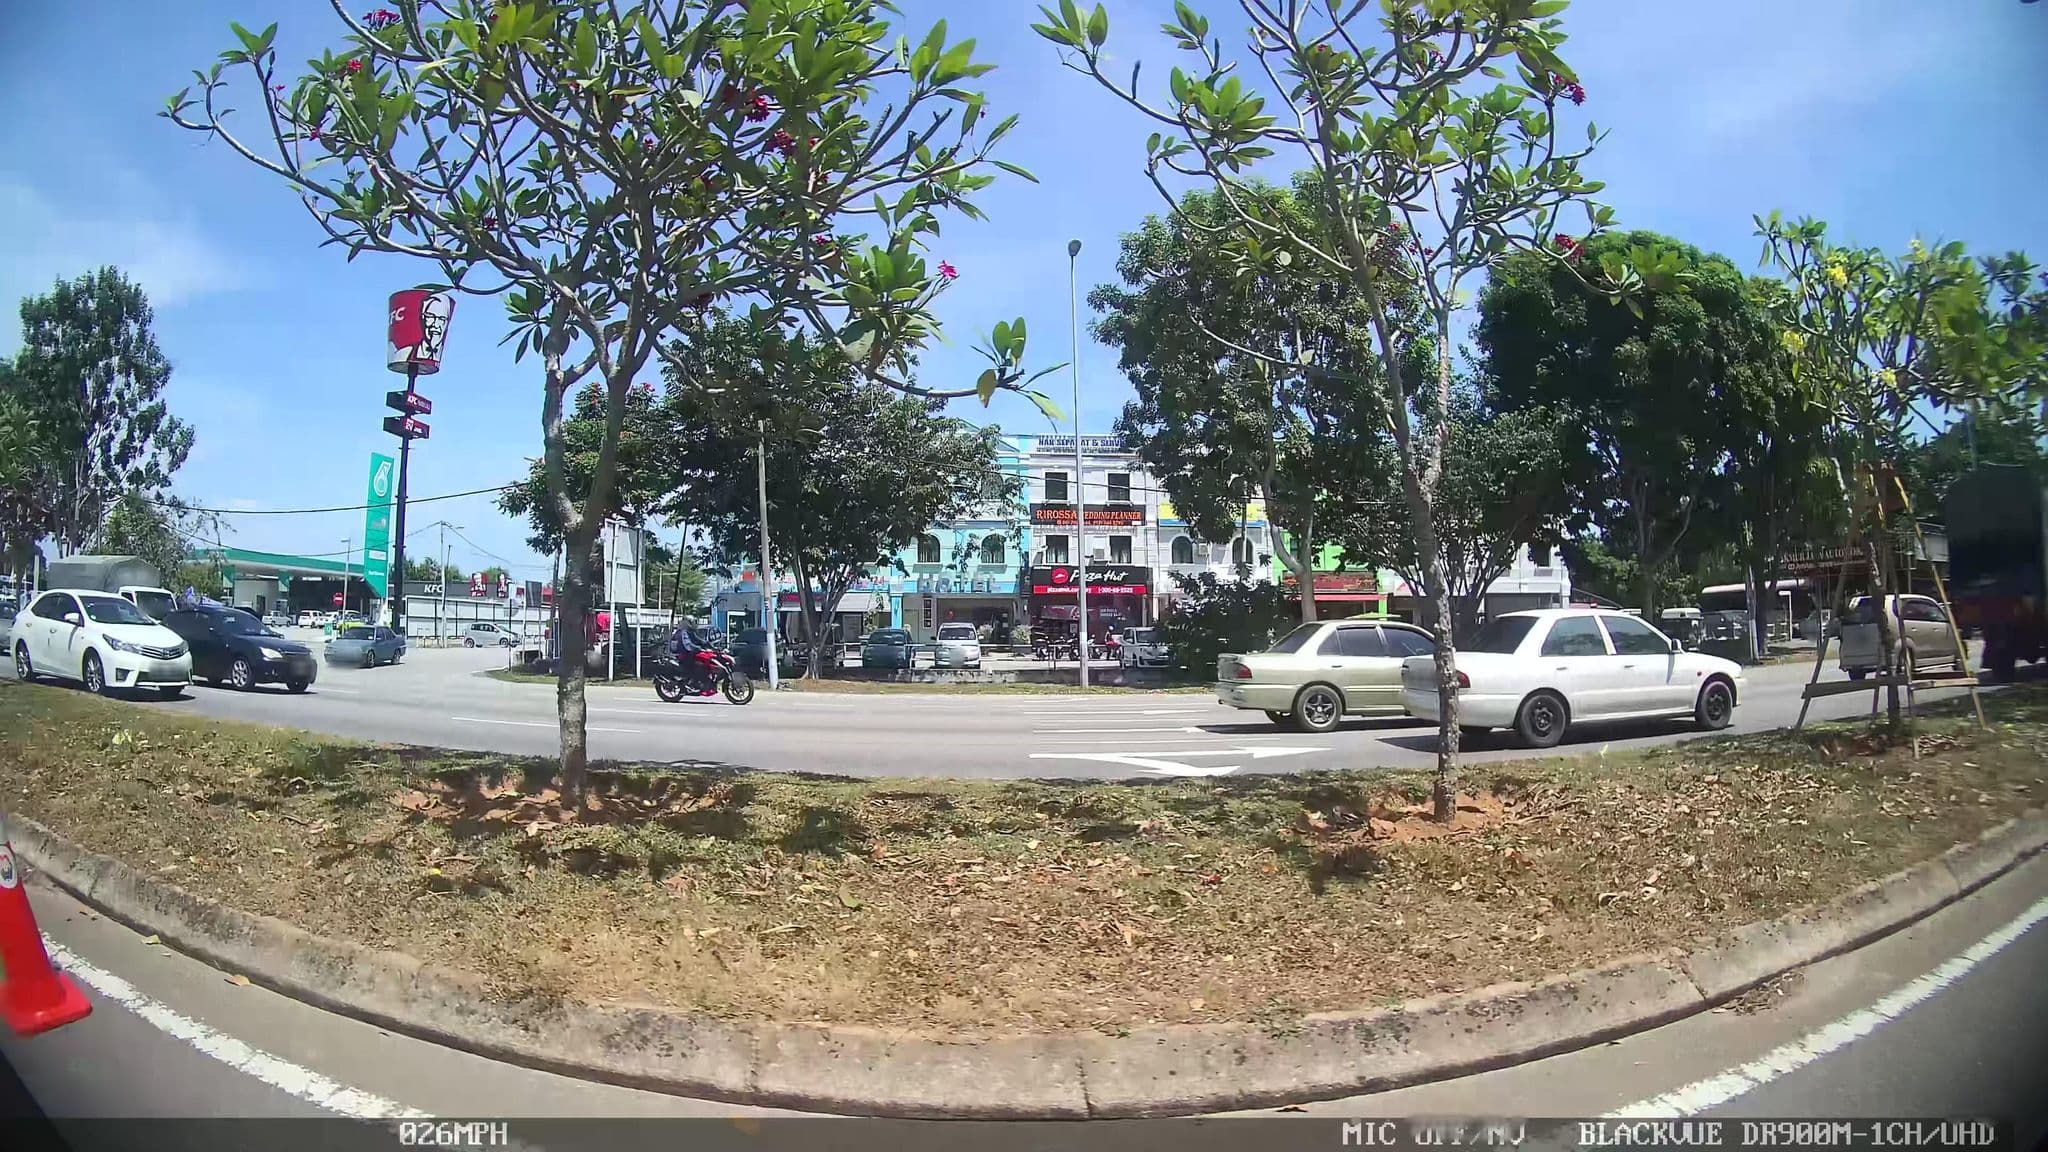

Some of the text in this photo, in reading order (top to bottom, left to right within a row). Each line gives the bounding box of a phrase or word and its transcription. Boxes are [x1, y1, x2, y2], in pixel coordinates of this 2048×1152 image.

[1036, 510, 1142, 520] RIROSSA EDDING PLANNER
[1070, 569, 1129, 582] Pzza Hut
[423, 584, 444, 593] KFC
